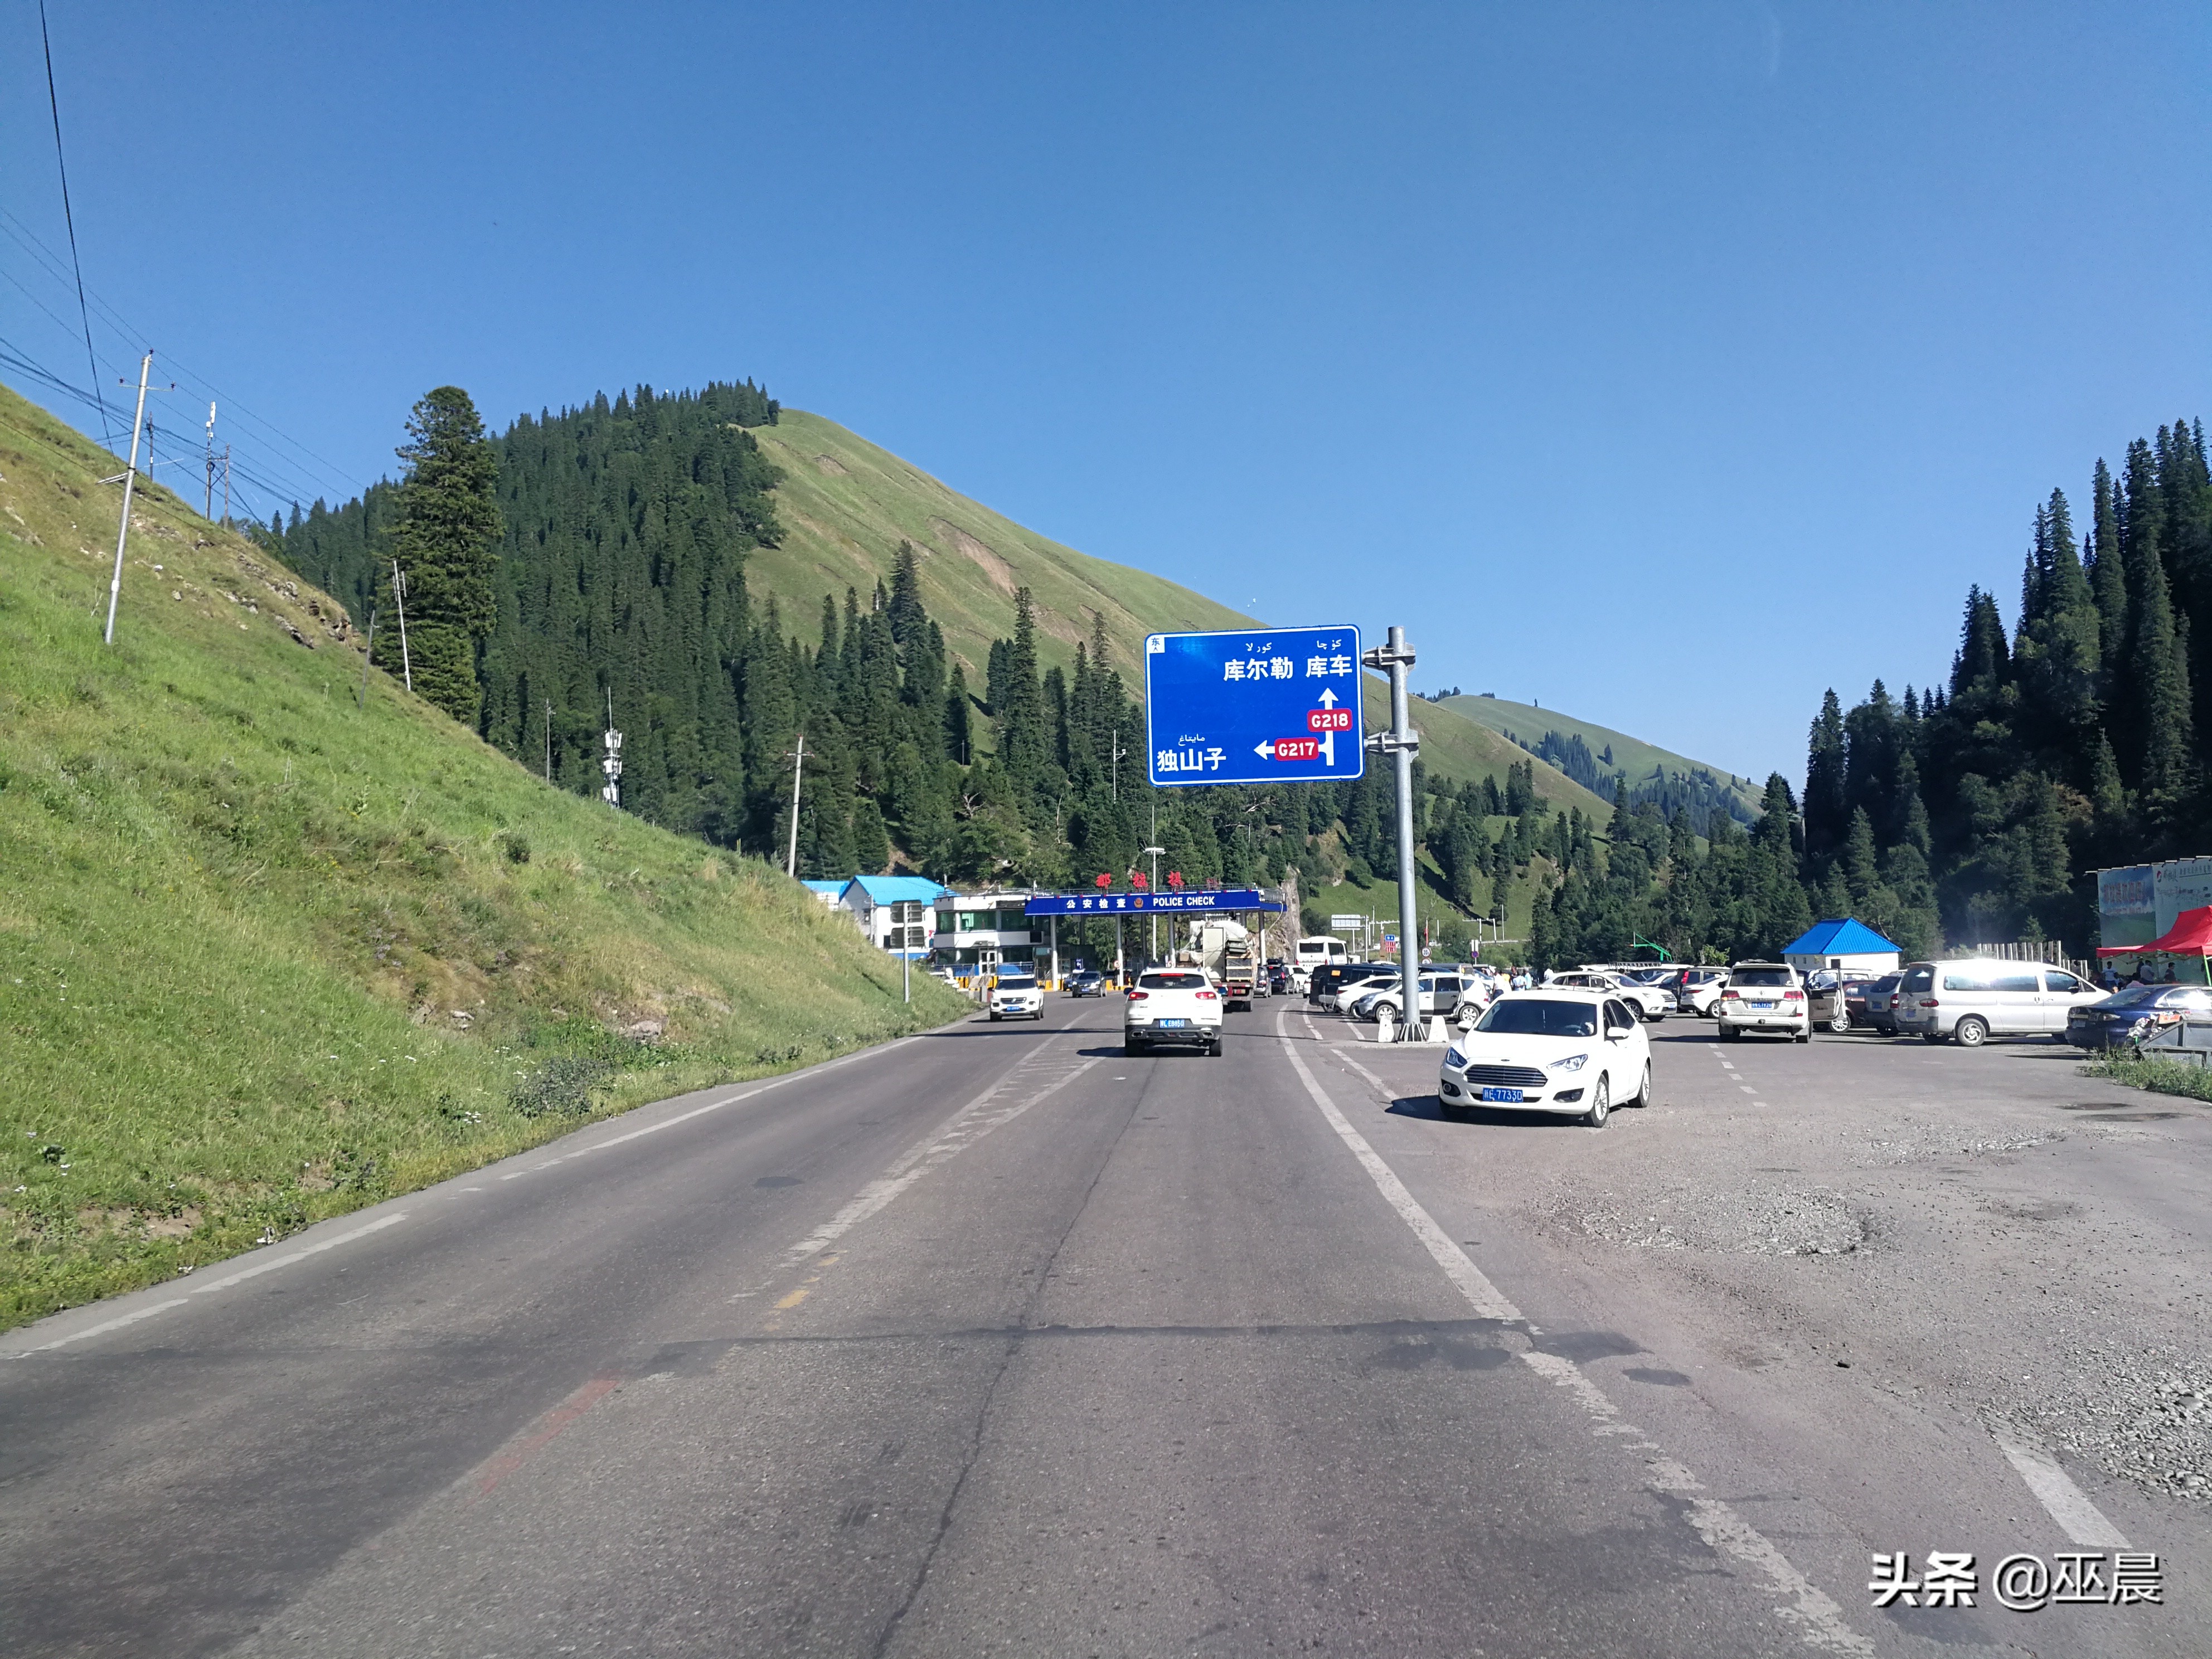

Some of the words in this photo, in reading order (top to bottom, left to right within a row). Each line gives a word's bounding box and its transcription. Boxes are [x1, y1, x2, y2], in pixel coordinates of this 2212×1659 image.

[1223, 656, 1294, 681] 库尔勒
[1305, 654, 1353, 678] 库车
[1311, 713, 1348, 728] G218
[1278, 742, 1315, 757] G217
[1157, 747, 1226, 773] 独山子
[1066, 898, 1126, 909] 公安检查
[1153, 896, 1183, 907] POLICE
[1186, 896, 1215, 906] CHECK
